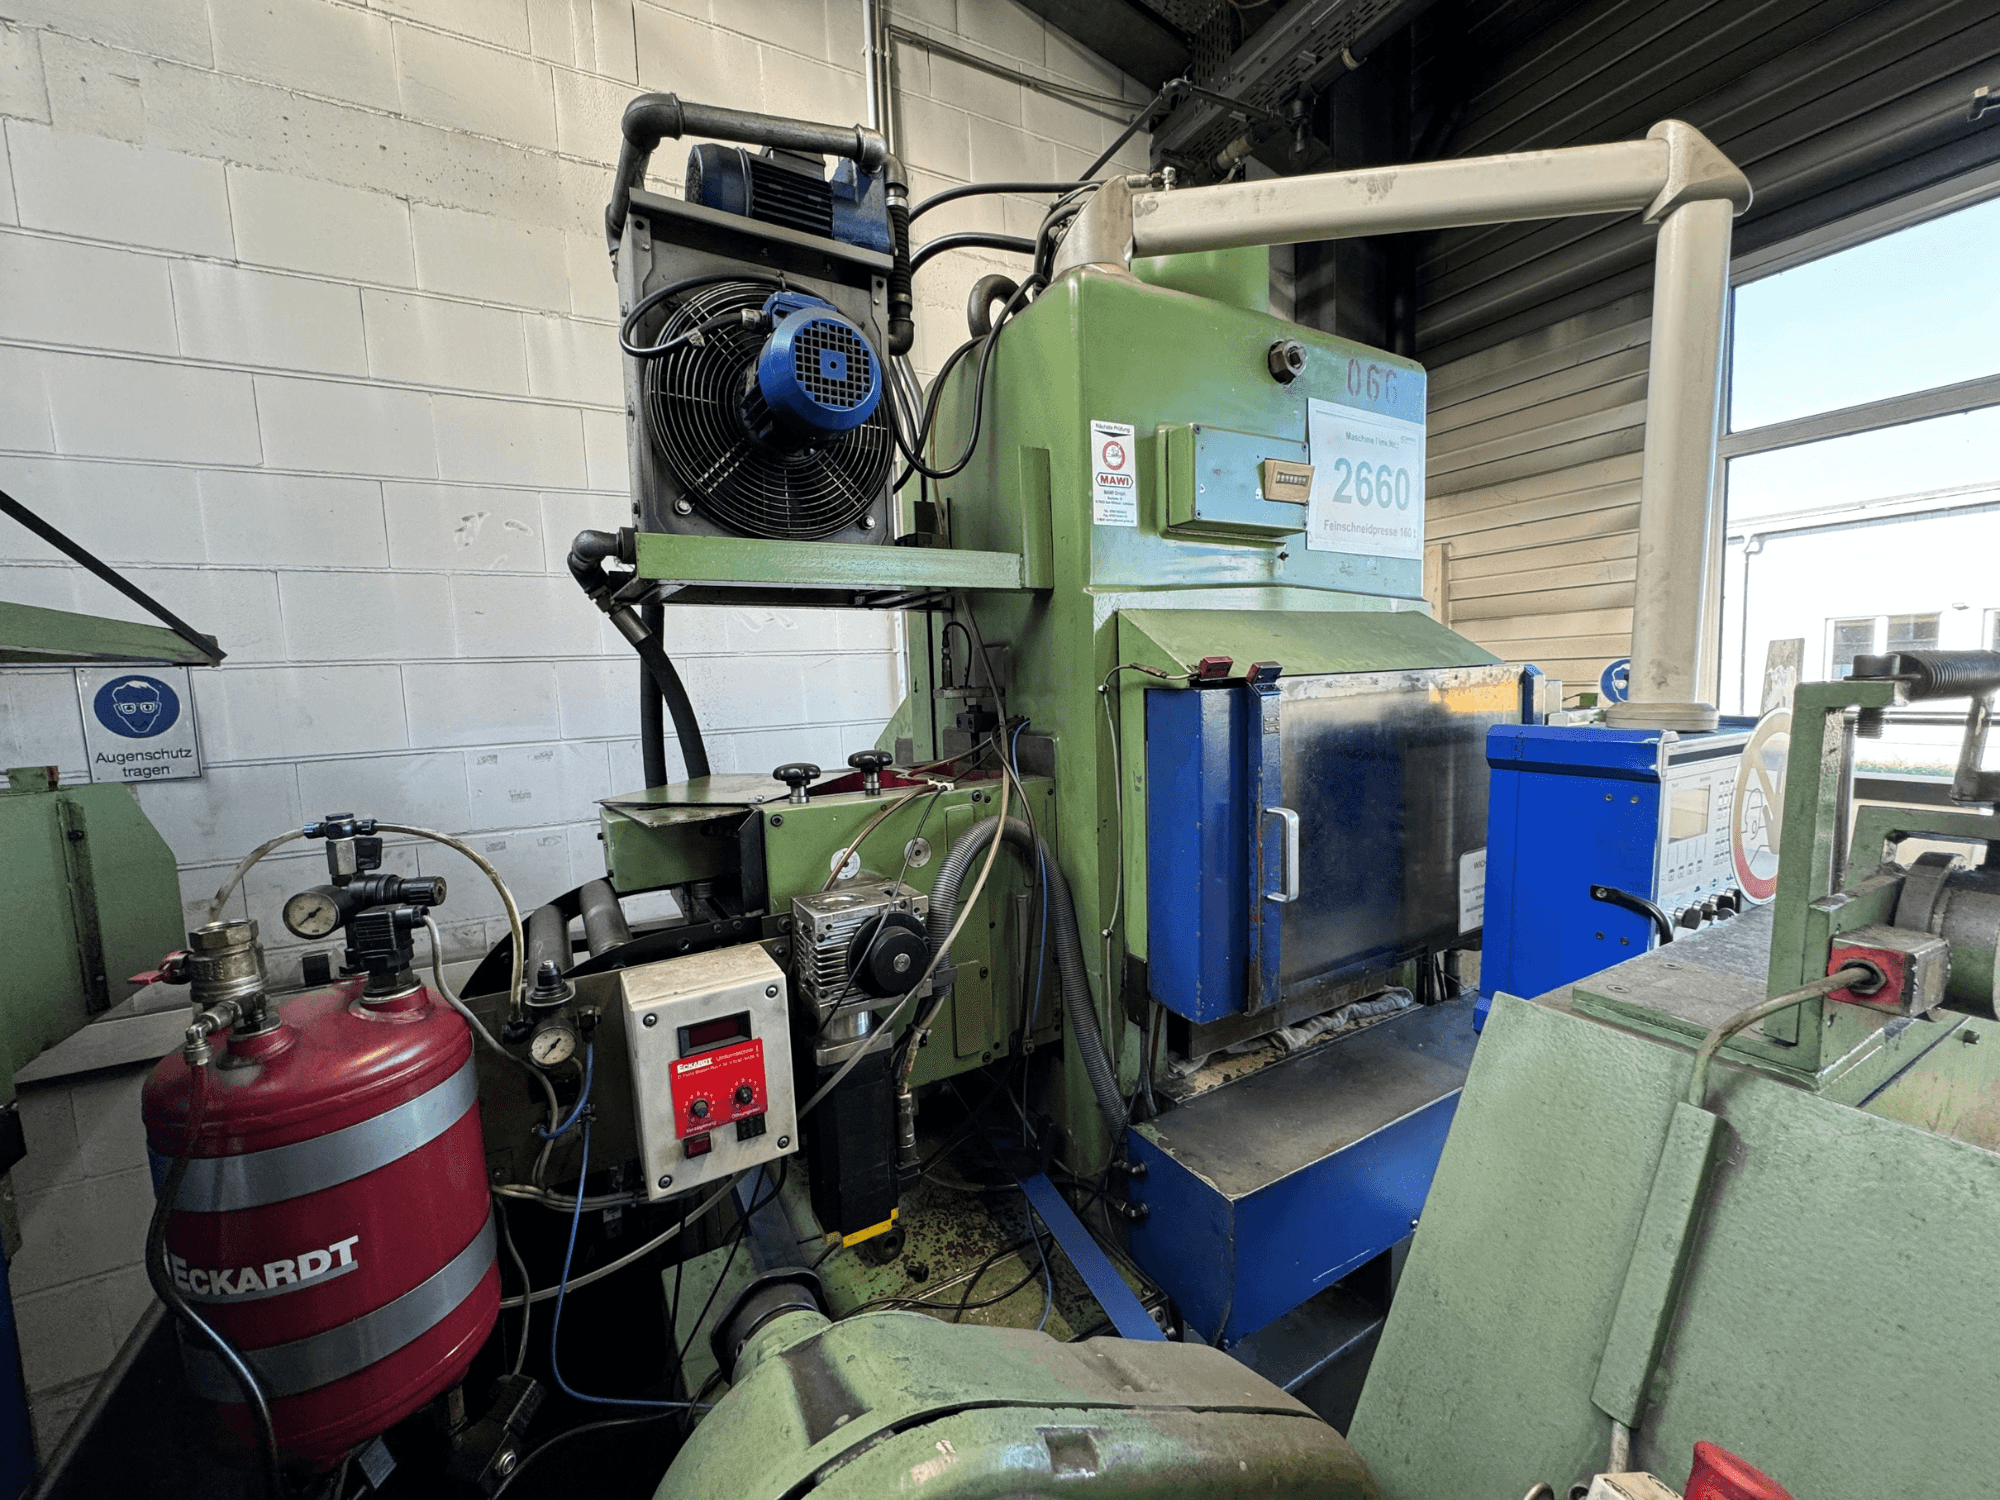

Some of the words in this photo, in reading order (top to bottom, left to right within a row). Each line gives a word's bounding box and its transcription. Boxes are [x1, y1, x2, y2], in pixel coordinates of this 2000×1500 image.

[1100, 475, 1129, 486] MAWI
[1332, 457, 1410, 511] 2660
[1323, 519, 1398, 538] Feinschneidpresse
[1400, 526, 1412, 538] 160
[95, 747, 193, 765] Augenschutz
[122, 765, 171, 779] tragen
[677, 1057, 713, 1074] ECKARDT
[170, 1235, 360, 1296] ECKARDT
